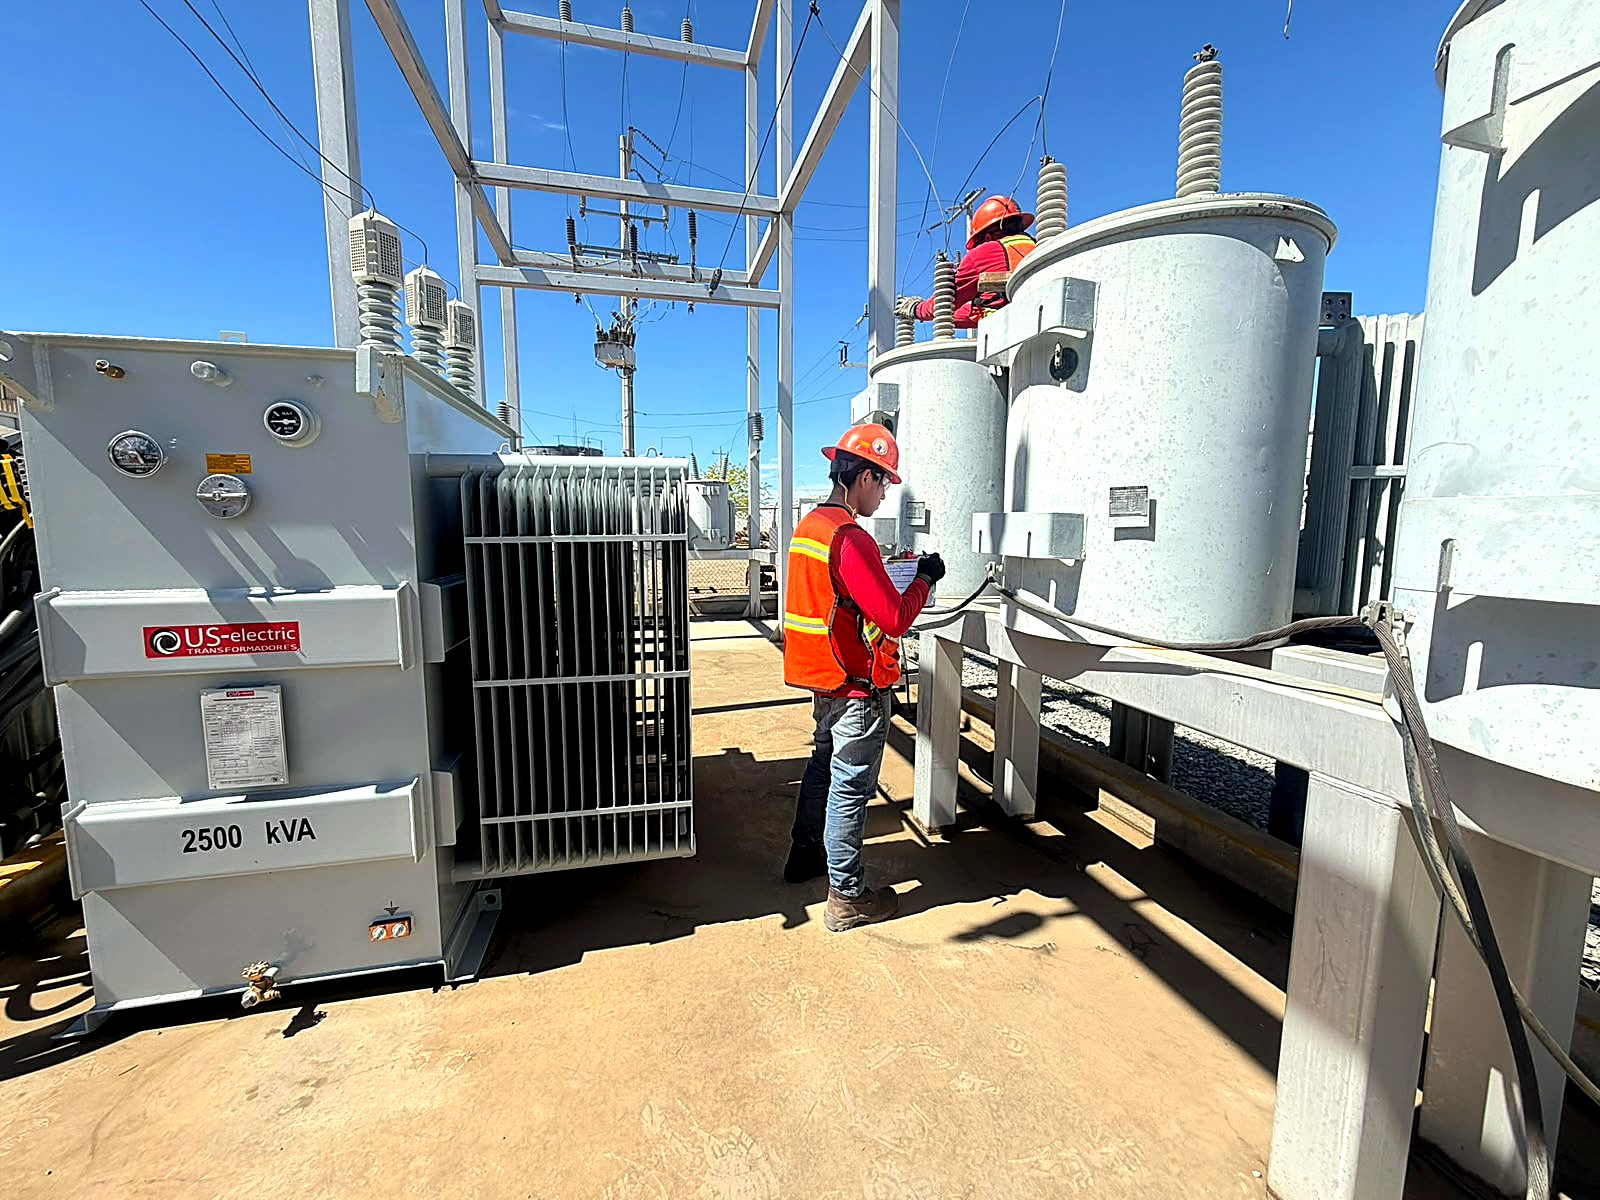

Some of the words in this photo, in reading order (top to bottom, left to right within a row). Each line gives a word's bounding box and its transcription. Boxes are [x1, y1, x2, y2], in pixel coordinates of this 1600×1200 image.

[184, 626, 296, 648] US-electric
[186, 643, 298, 655] TRANSFORMADORES
[181, 824, 242, 853] 2500
[265, 817, 317, 845] kVA
